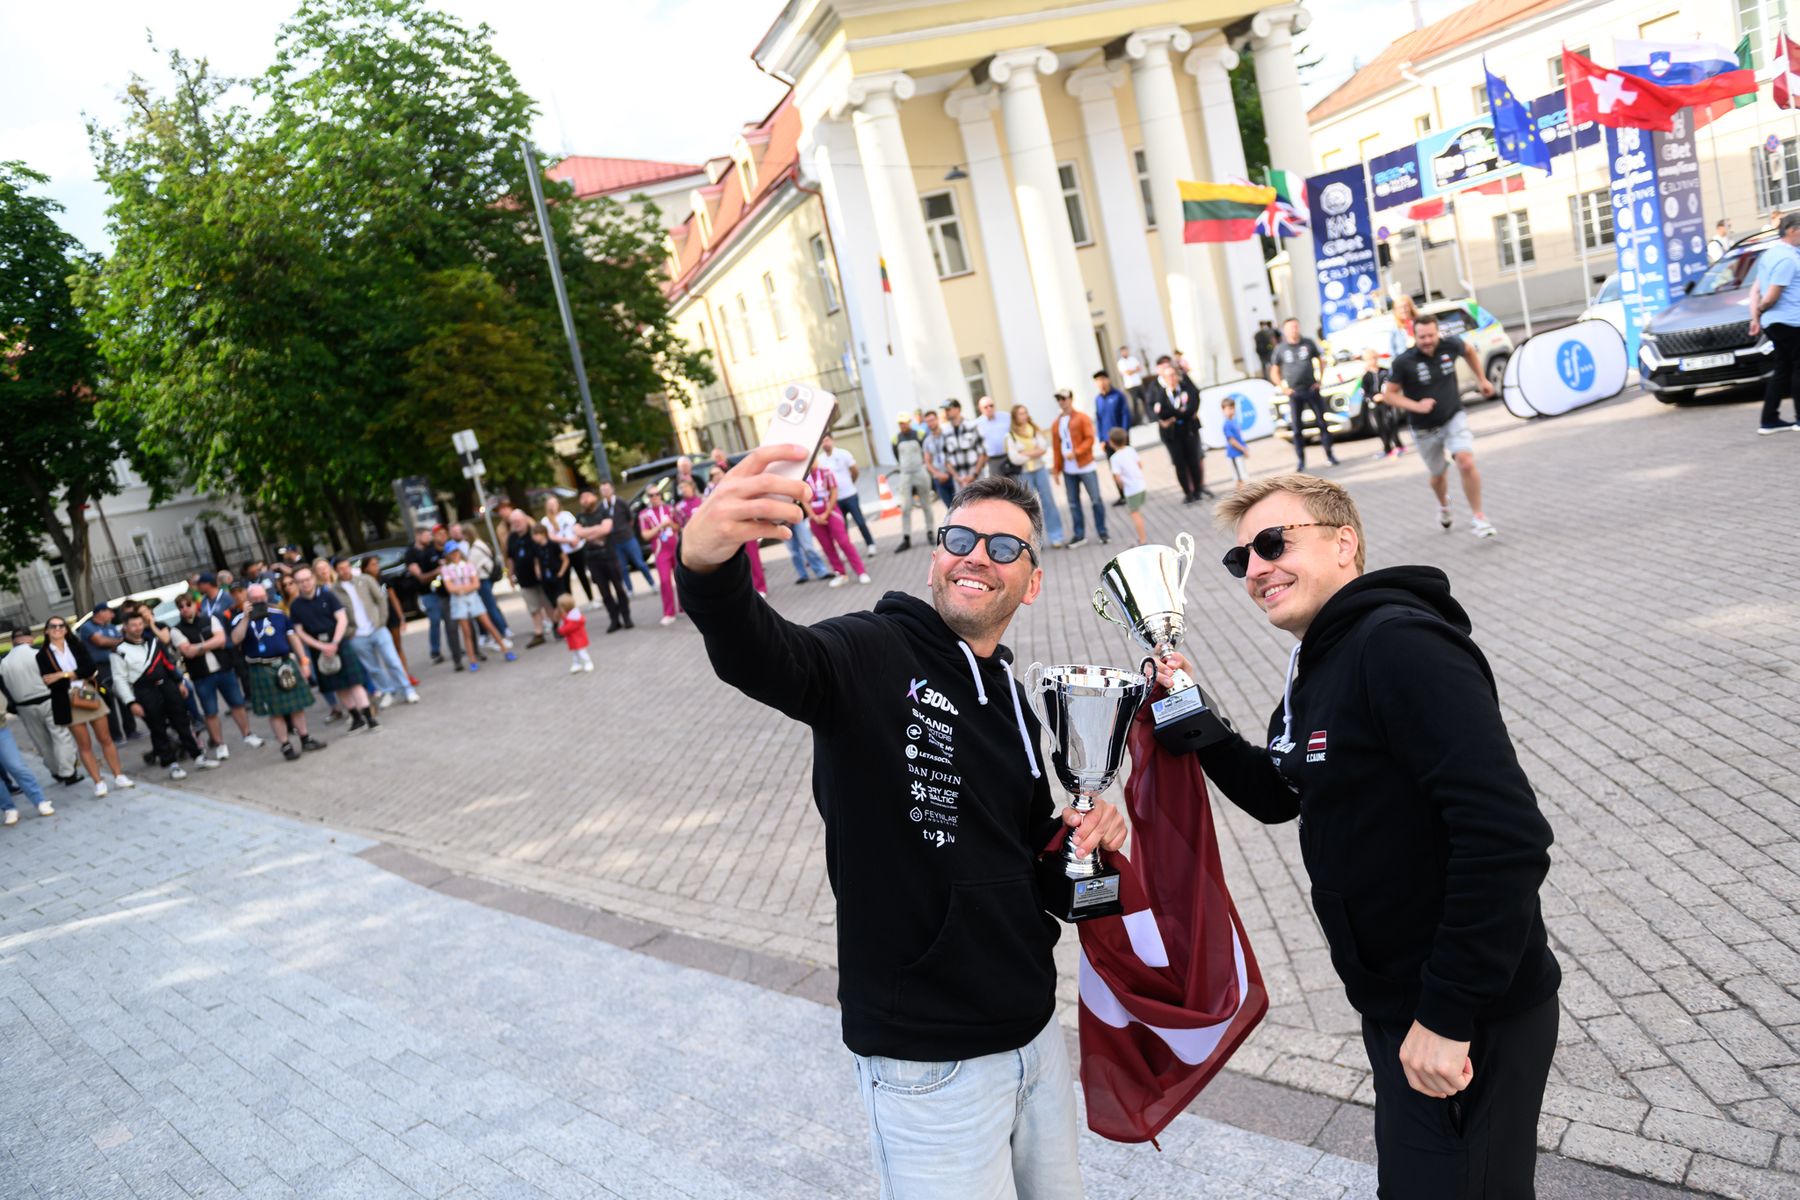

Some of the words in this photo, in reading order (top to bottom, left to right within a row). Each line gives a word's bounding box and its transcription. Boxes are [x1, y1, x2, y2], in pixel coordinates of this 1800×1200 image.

[912, 708, 953, 735] SKANDI
[907, 763, 928, 777] DAN
[929, 770, 961, 785] JOHN
[923, 829, 955, 848] tv3.lv
